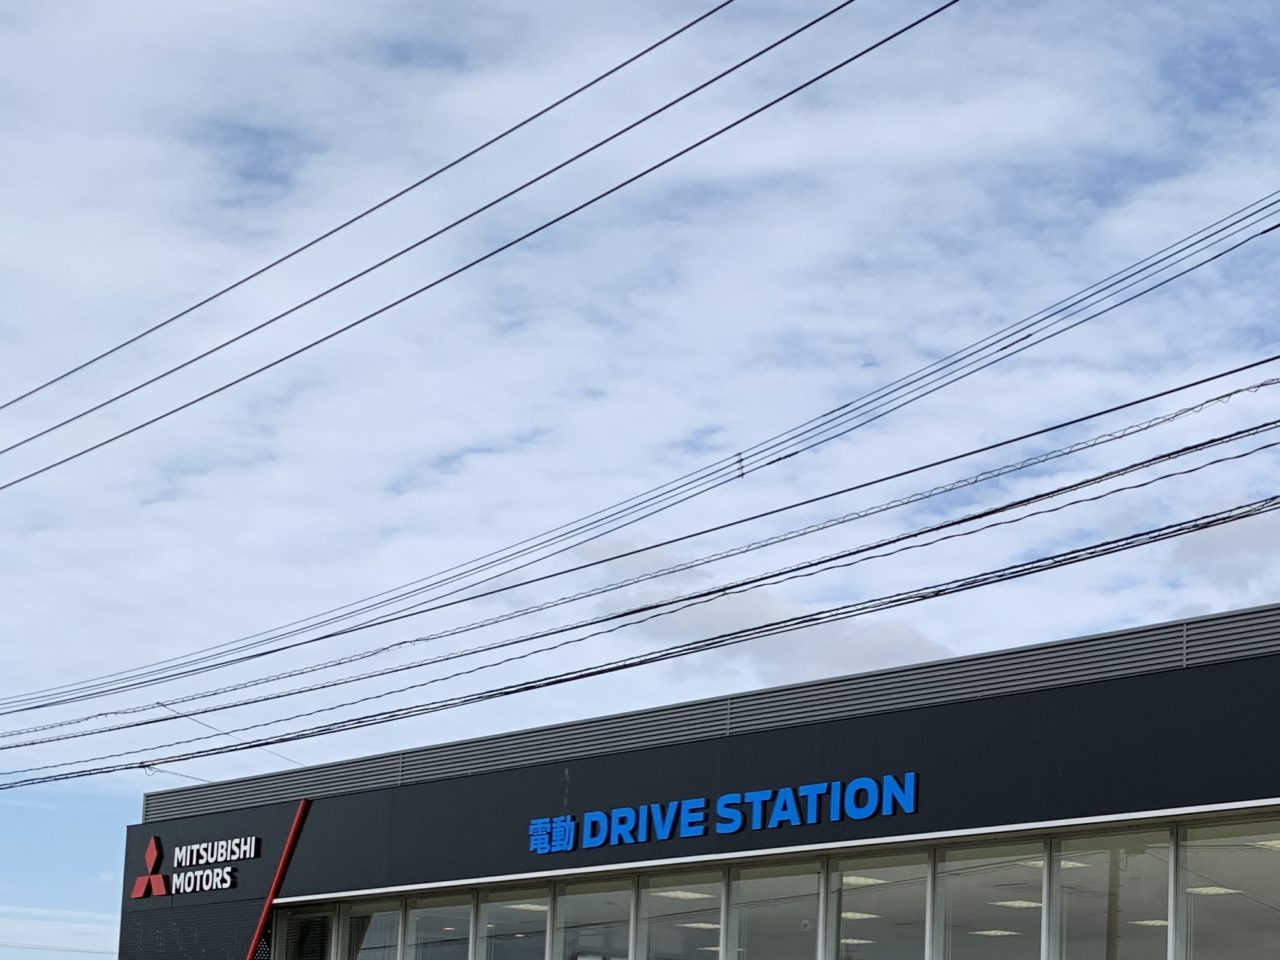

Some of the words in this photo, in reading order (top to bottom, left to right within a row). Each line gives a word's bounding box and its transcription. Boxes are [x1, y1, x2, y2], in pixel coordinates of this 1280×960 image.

[528, 815, 574, 855] 電動
[582, 798, 706, 849] DRIVE
[715, 772, 915, 835] STATION
[173, 836, 256, 867] MITSUBISHI
[171, 866, 232, 895] MOTORS
